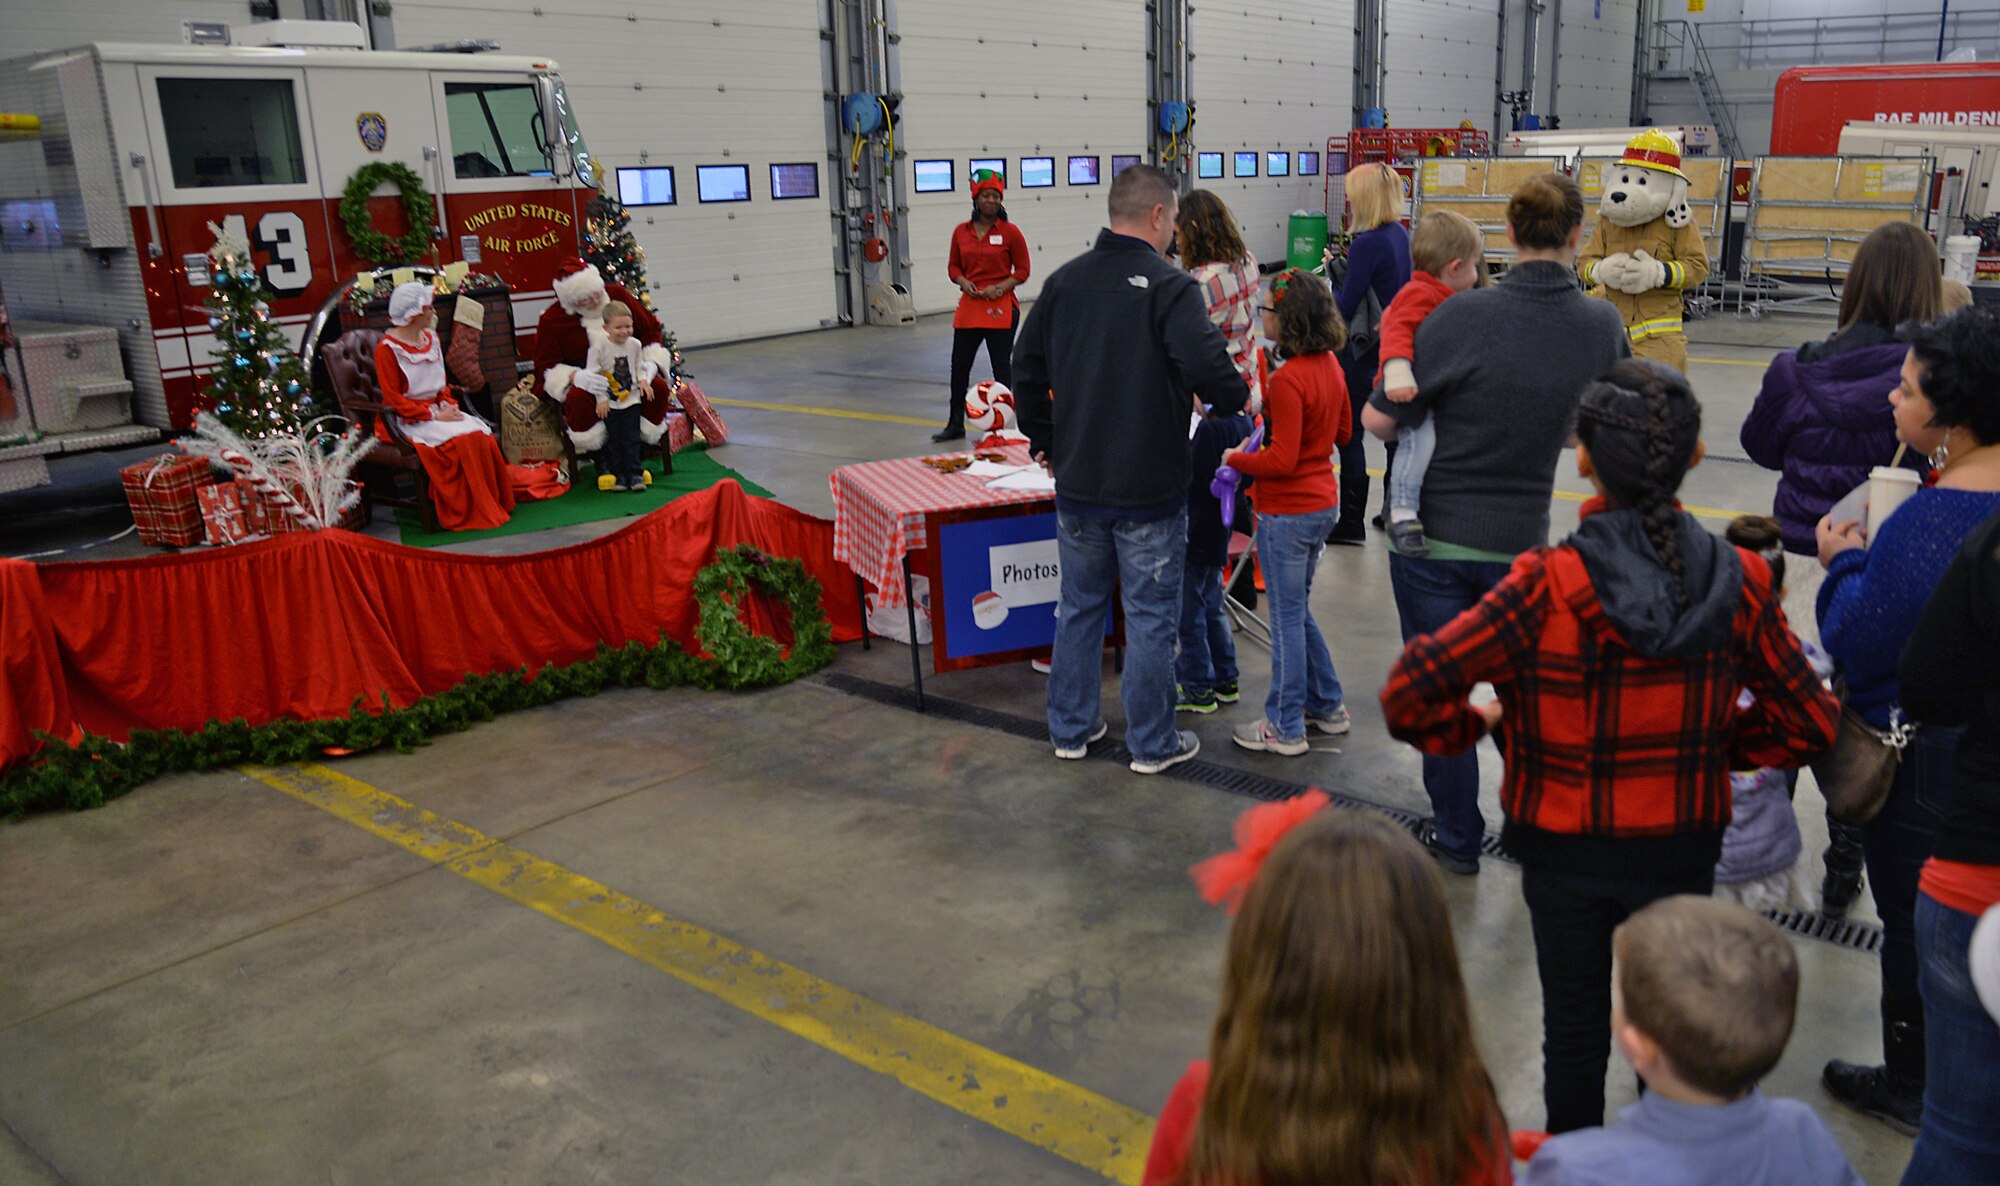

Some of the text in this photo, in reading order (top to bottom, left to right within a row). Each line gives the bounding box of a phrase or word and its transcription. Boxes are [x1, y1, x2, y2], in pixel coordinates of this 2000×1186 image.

[1918, 111, 2000, 126] MILDEN
[464, 203, 571, 232] UNITED STATES
[484, 229, 560, 253] AIR FORCE
[1003, 563, 1058, 584] Photos
